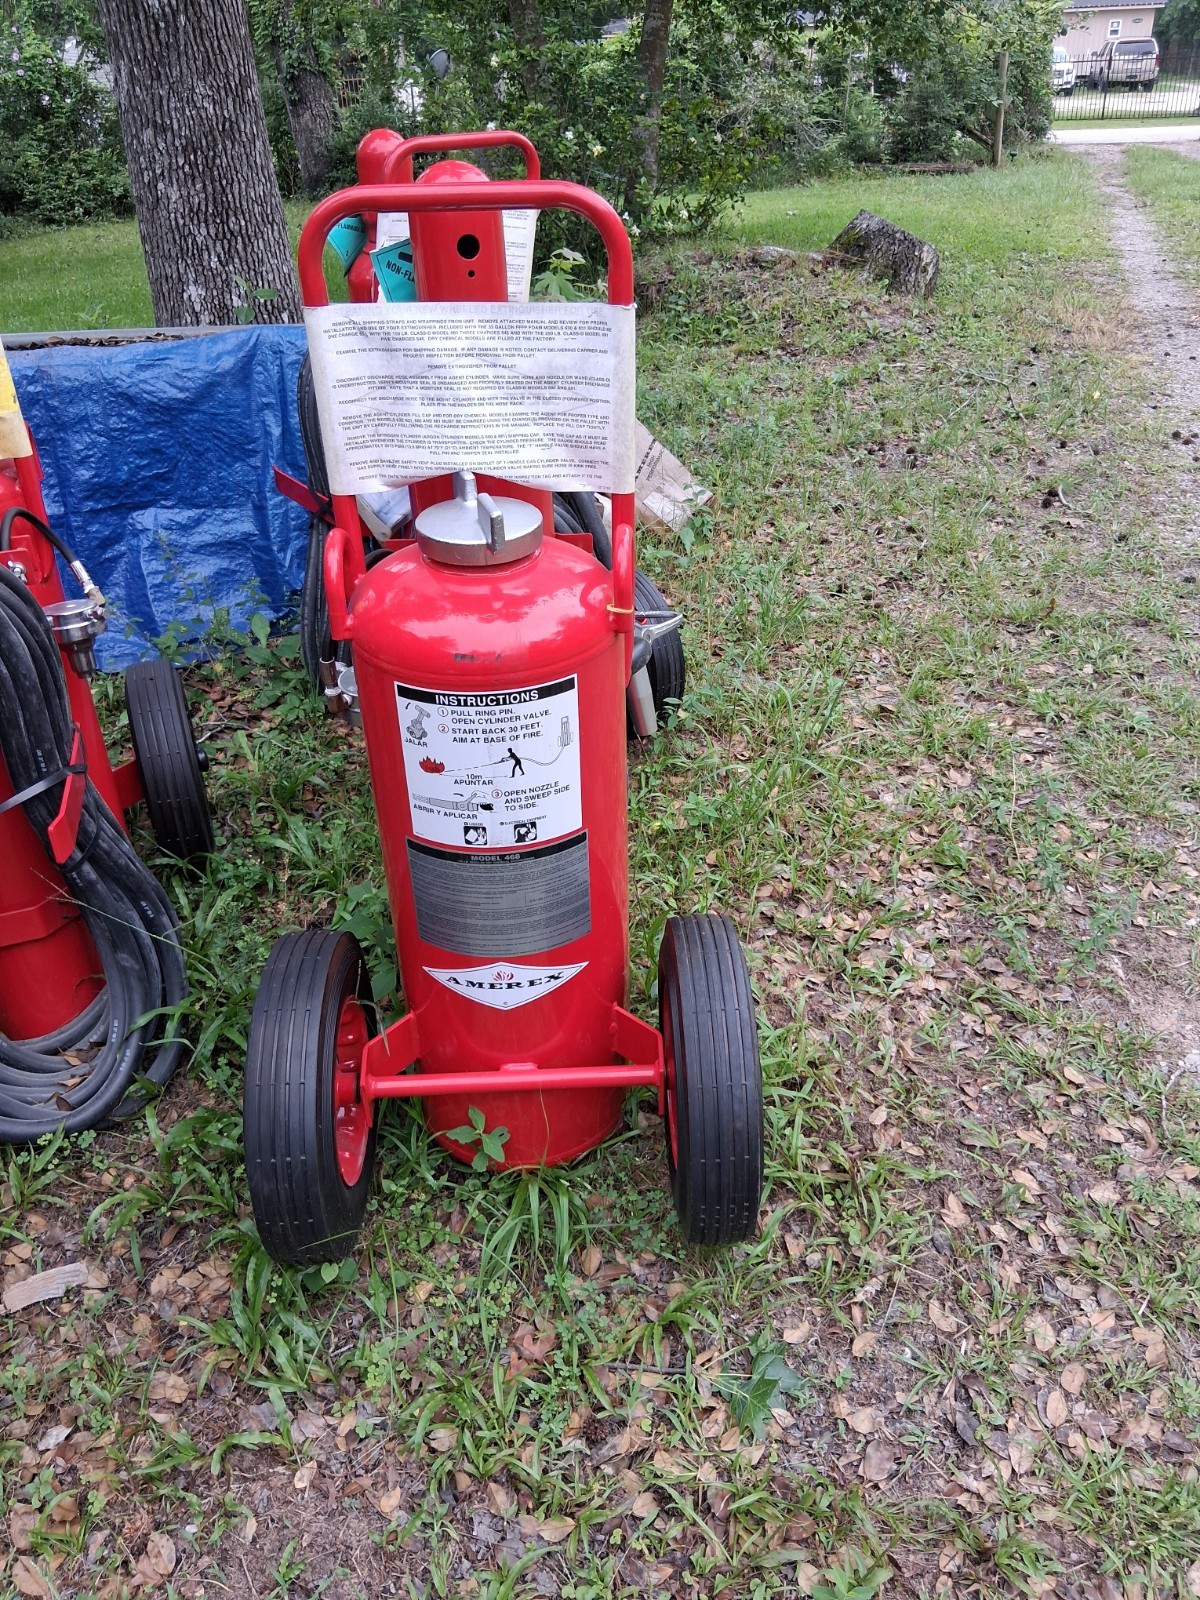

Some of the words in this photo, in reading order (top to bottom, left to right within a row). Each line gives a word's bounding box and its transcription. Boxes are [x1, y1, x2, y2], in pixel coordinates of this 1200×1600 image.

[490, 306, 560, 314] EXTINGUISHER
[435, 690, 539, 706] INSTRUCTIONS
[478, 715, 521, 725] CYLINDER
[523, 709, 552, 720] VALVE.
[520, 722, 543, 730] FEET.
[523, 731, 543, 740] FIRE.
[405, 738, 428, 748] JALAR
[529, 781, 559, 793] NOZZLE
[524, 792, 552, 802] SWEEP
[554, 785, 571, 795] SIDE
[414, 804, 434, 814] ABRIR
[444, 810, 478, 820] APLICAR
[518, 803, 539, 811] SIDE.
[446, 971, 565, 989] AMEREX
